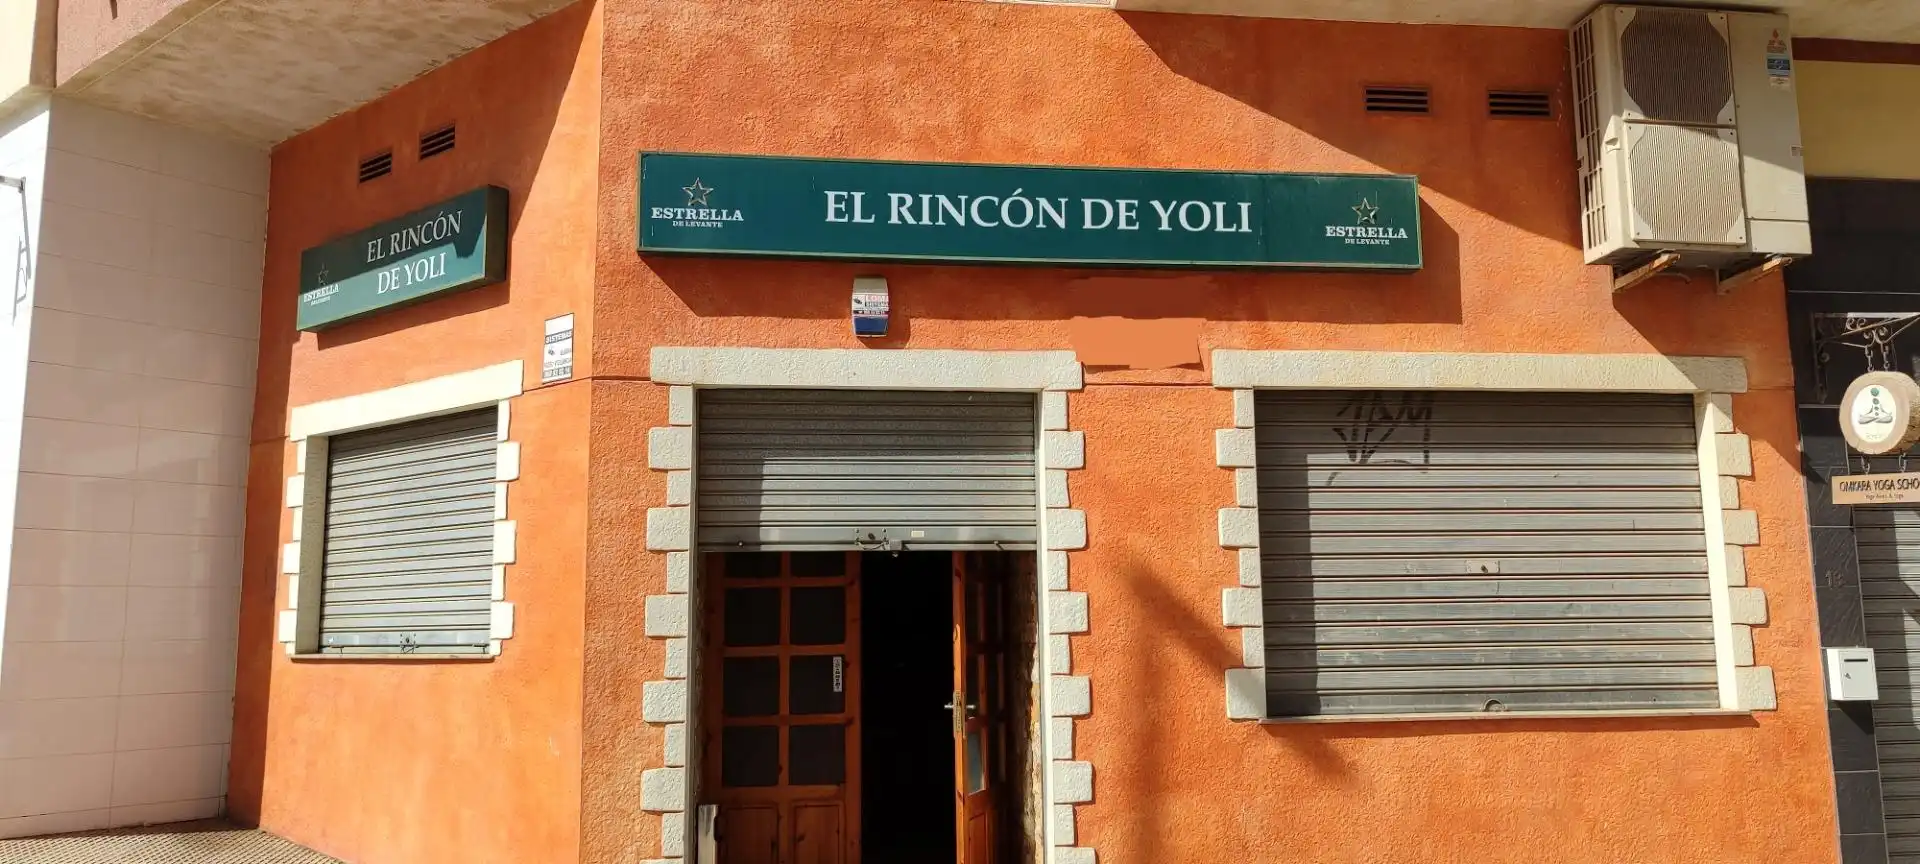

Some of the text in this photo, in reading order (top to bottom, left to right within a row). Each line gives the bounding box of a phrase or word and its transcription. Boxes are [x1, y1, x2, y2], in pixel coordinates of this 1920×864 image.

[651, 207, 744, 221] ESTRELLA
[824, 187, 1252, 232] EL RINCÓN DE YOLI
[367, 210, 463, 263] EL RINCÓN
[1325, 226, 1408, 238] ESTRELLA
[377, 252, 447, 294] DE YOLI
[1873, 479, 1895, 491] YOGA
